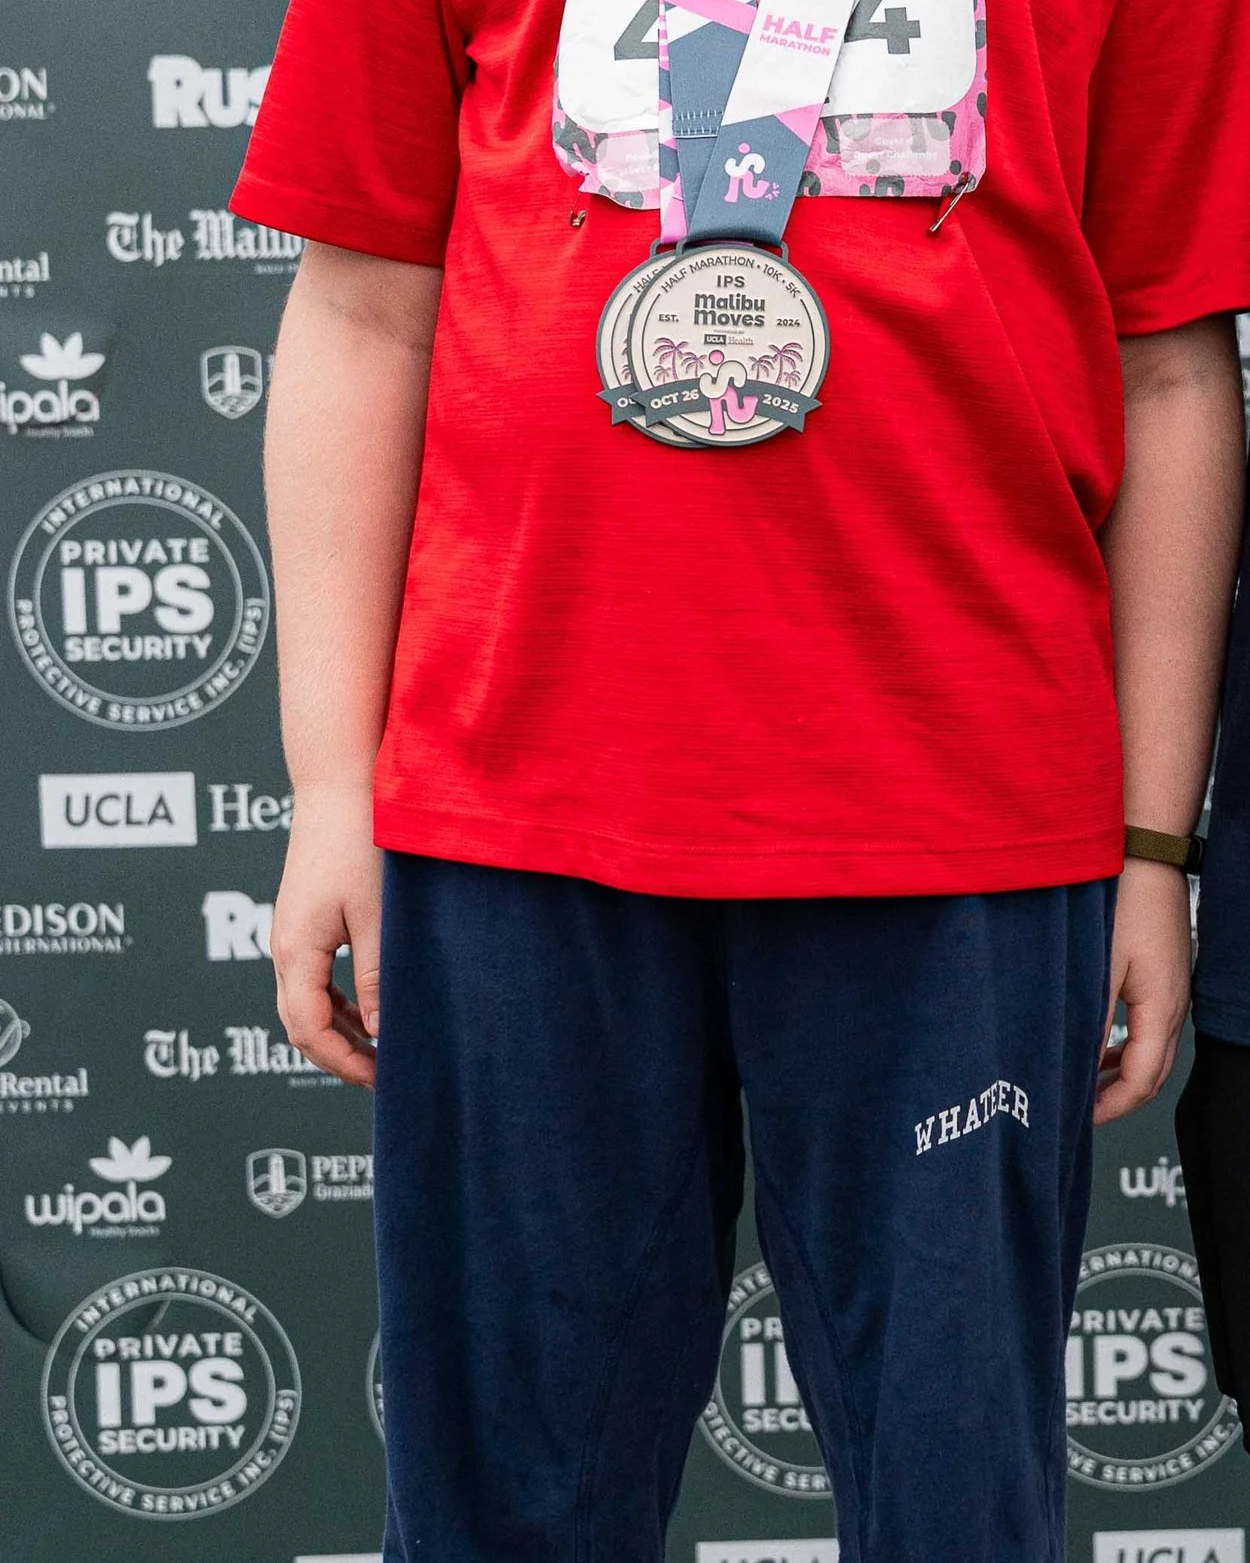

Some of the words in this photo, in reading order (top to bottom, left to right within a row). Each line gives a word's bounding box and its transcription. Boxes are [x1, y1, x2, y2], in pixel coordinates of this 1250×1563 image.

[758, 33, 831, 57] MARATHON
[762, 14, 839, 45] HALF
[106, 211, 185, 267] The
[661, 267, 688, 293] HALF
[690, 255, 755, 274] MARATHON
[763, 263, 783, 281] 10K
[785, 281, 801, 298] 5K
[717, 275, 745, 288] IPS
[658, 313, 680, 323] EST.
[776, 318, 801, 327] 2024
[705, 335, 725, 344] UCLA
[728, 336, 754, 346] Health
[0, 380, 100, 436] ipala
[650, 392, 680, 410] OCT
[682, 389, 699, 402] 26
[762, 393, 800, 413] 2025
[41, 478, 224, 535] INTERNATIONAL
[60, 538, 210, 566] PRIVATE
[61, 564, 214, 635] IPS
[16, 599, 102, 716] PROTECTIVE
[107, 692, 203, 723] SERVICE
[63, 635, 212, 662] SECURITY
[64, 794, 174, 827] UCLA
[0, 902, 125, 937] DISON
[144, 1028, 220, 1081] The
[915, 1080, 1029, 1156] WHATEER
[25, 1183, 166, 1236] wipala
[75, 1274, 258, 1332] INTERNATIONAL
[93, 1332, 243, 1360] PRIVATE
[1065, 1331, 1207, 1400] IPS
[96, 1356, 247, 1428] IPS
[1066, 1399, 1206, 1426] SECURITY
[50, 1395, 137, 1506] PROTECTIVE
[140, 1481, 237, 1513] SERVICE
[100, 1425, 245, 1455] SECURITY
[1102, 1453, 1192, 1483] SERVICE
